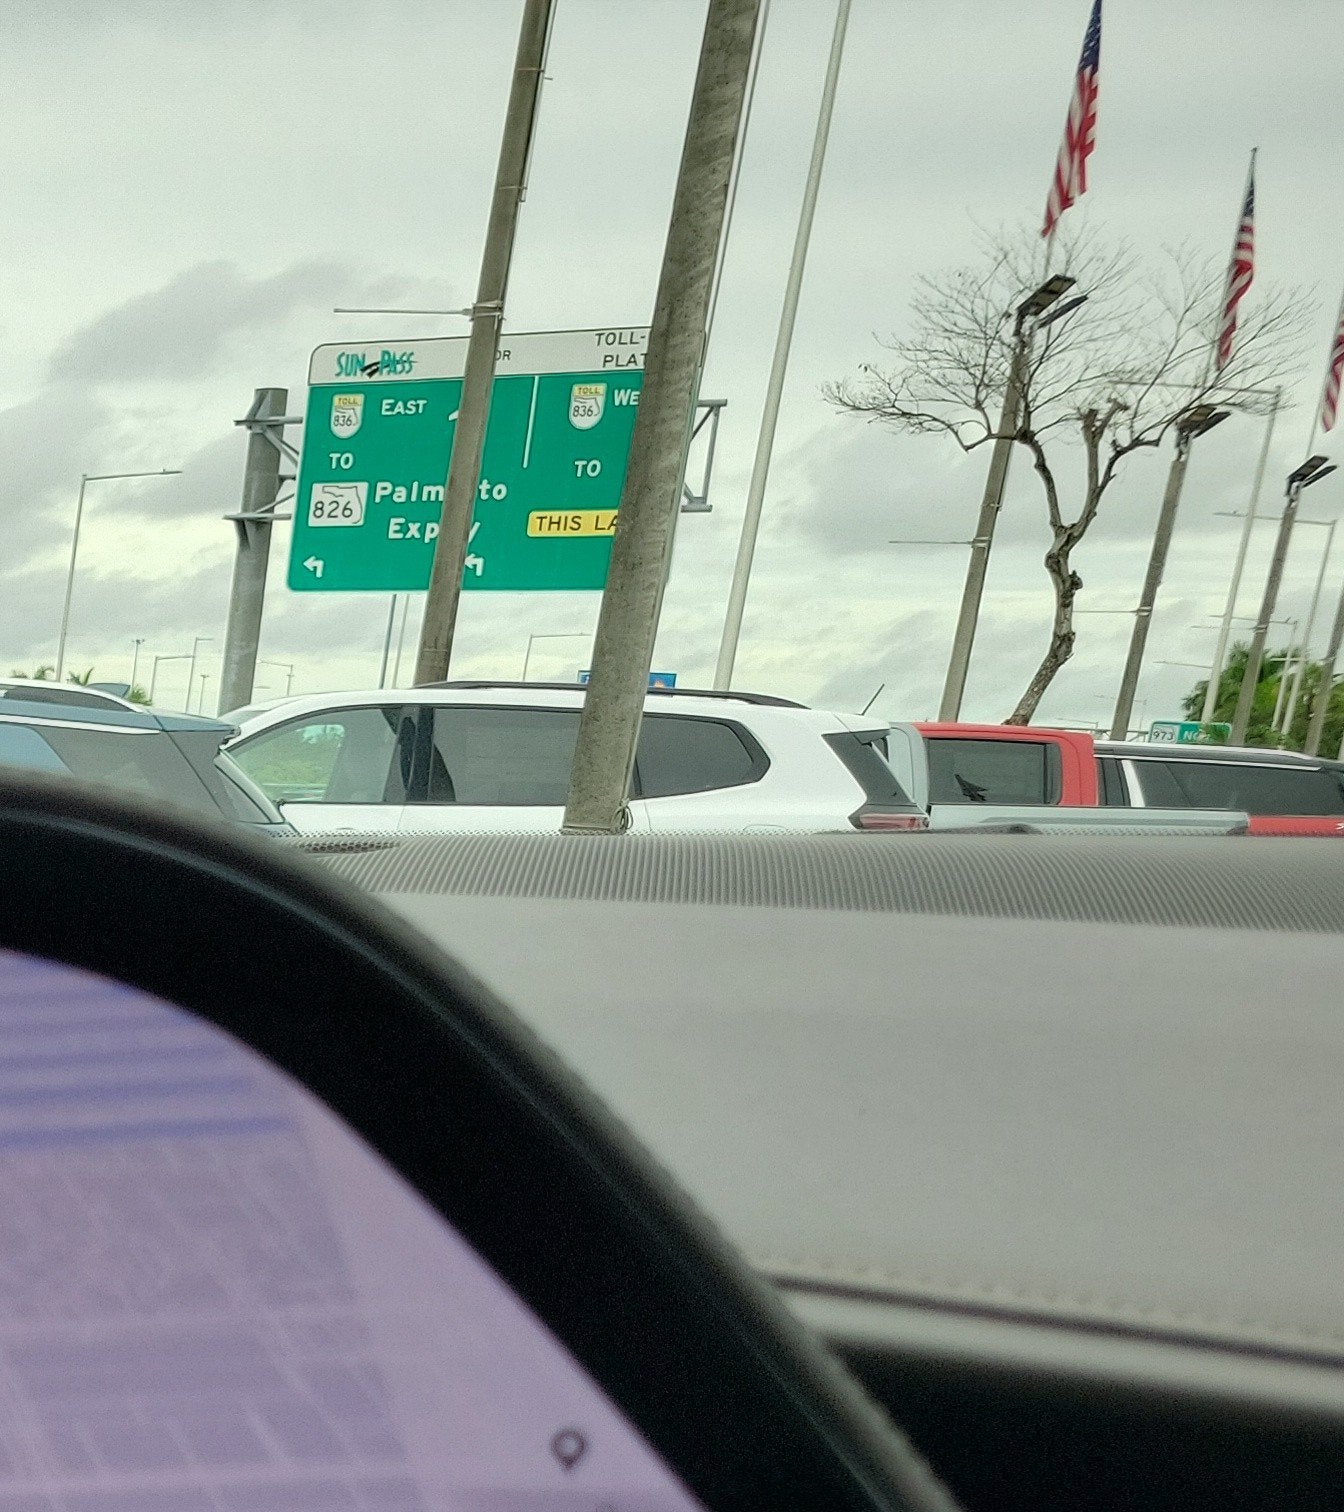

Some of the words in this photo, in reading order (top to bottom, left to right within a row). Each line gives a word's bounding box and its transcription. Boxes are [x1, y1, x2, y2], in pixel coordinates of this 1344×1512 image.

[577, 387, 600, 395] TOLL
[338, 397, 358, 406] TOLL
[381, 399, 427, 415] EAST
[572, 405, 594, 418] 836
[333, 415, 353, 428] 836
[329, 453, 354, 469] TO
[574, 459, 602, 477] TO
[312, 501, 354, 518] 826
[536, 515, 582, 531] THIS
